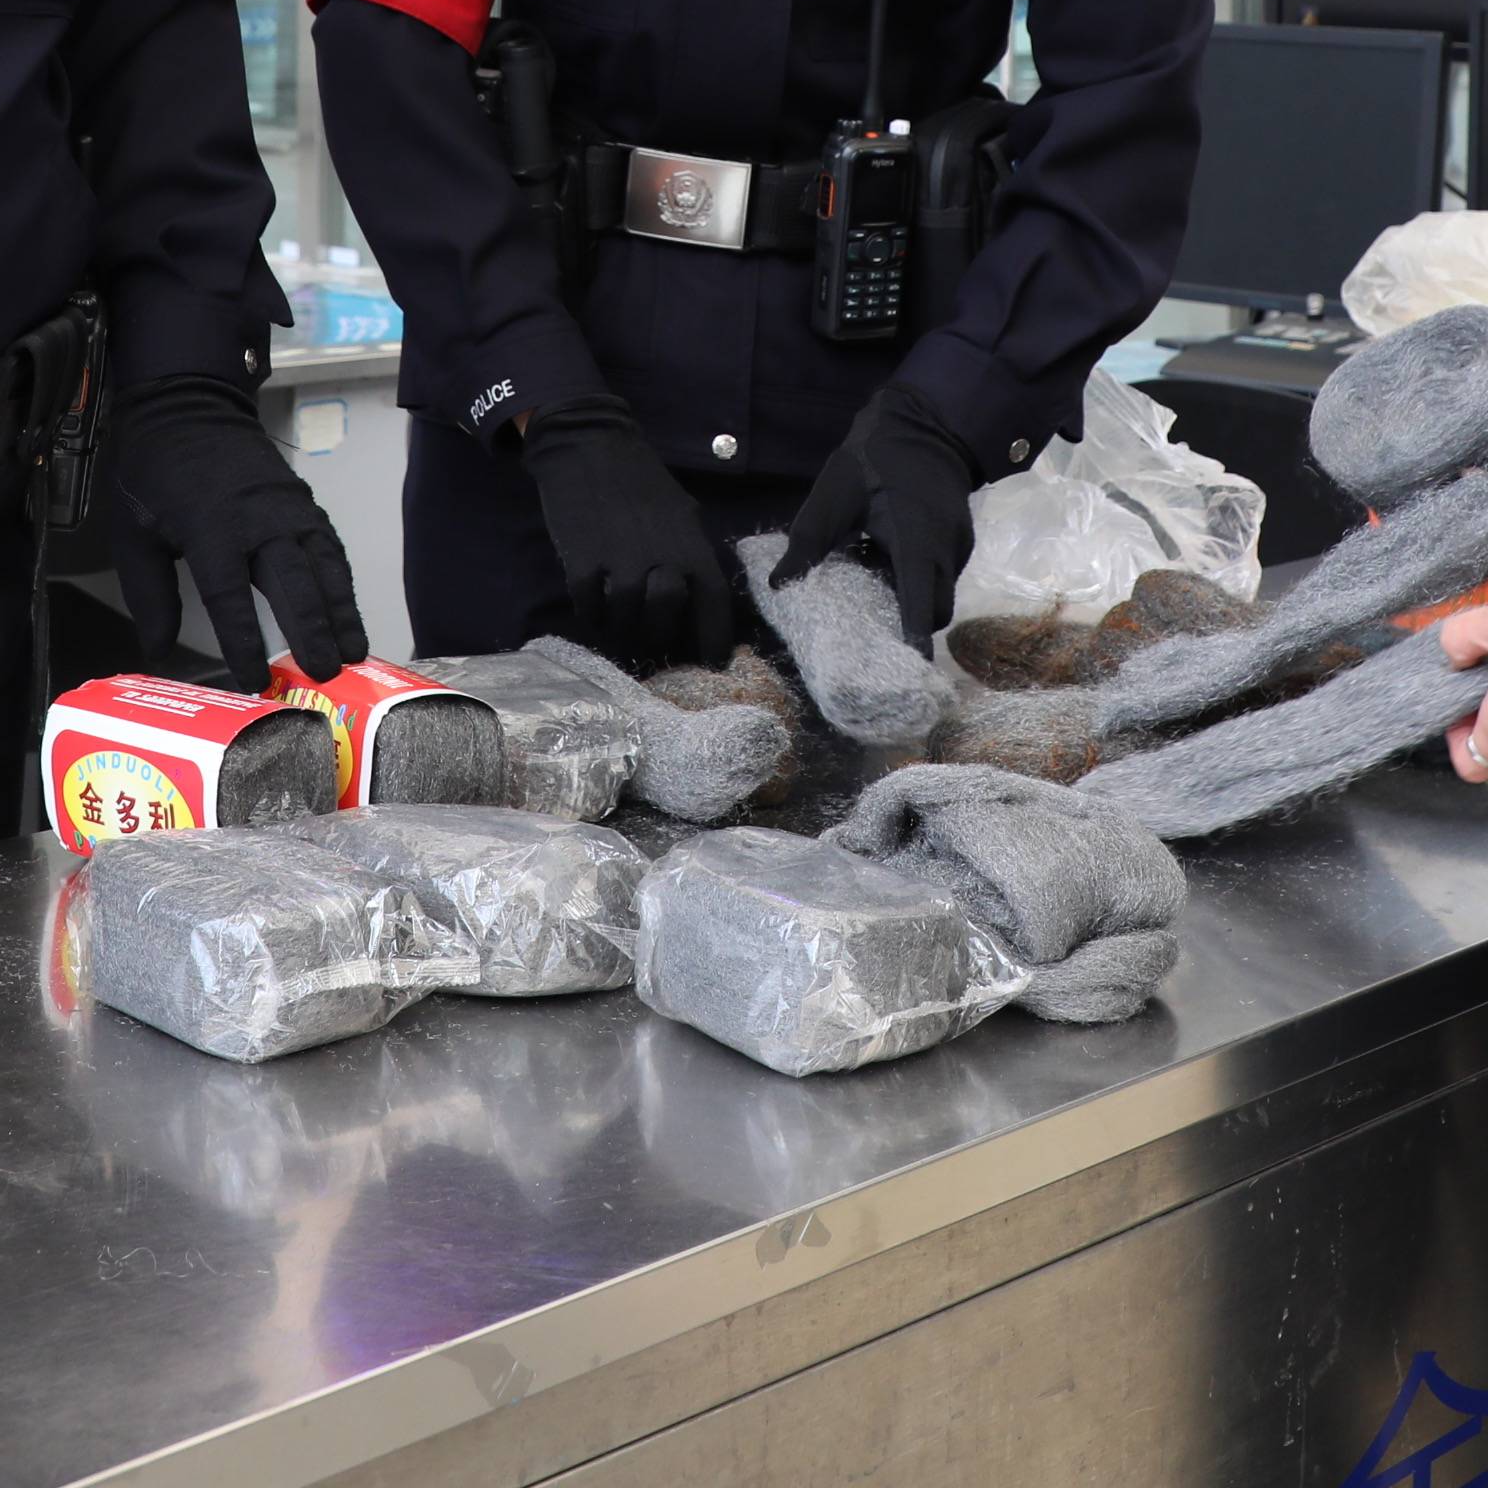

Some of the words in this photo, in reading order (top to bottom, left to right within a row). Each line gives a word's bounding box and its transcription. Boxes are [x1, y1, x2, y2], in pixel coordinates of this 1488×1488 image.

[470, 378, 516, 426] POLICE
[77, 752, 175, 802] JINDUOLI
[79, 781, 176, 834] 金多利
